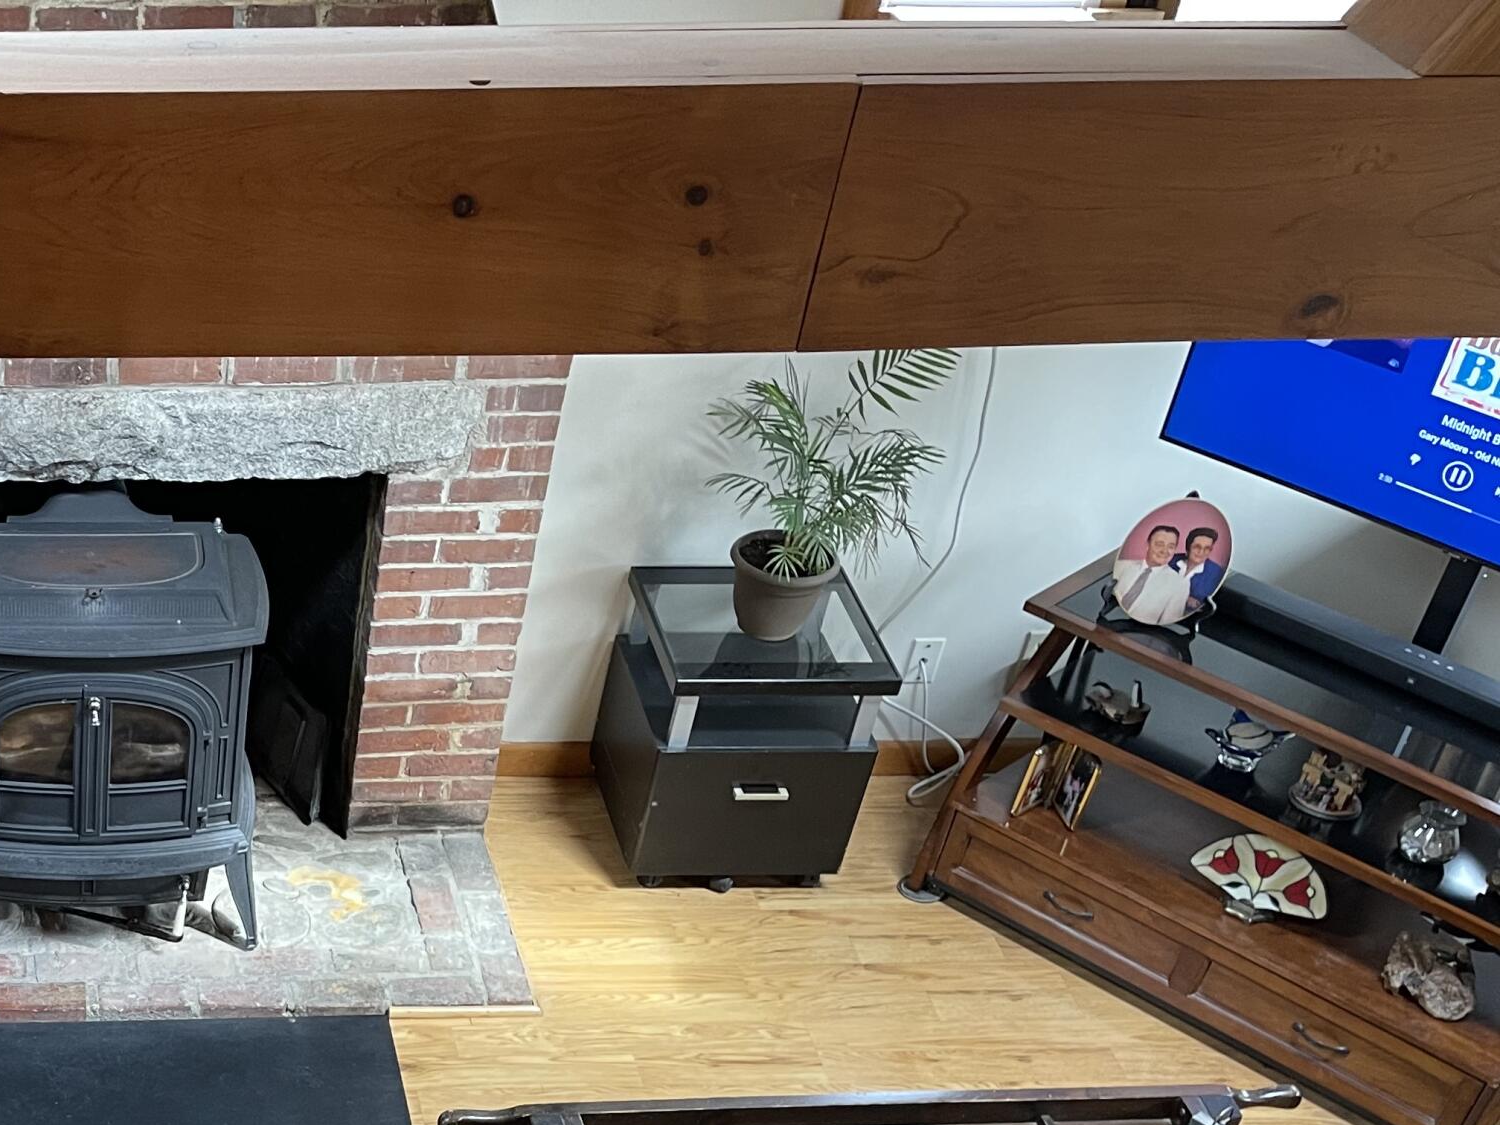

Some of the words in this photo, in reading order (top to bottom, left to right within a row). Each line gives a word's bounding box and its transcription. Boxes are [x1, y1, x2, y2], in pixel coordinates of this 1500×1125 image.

[1441, 415, 1492, 443] Midnight
[1418, 429, 1441, 446] Gary
[1440, 437, 1469, 456] Moore
[1474, 449, 1491, 464] Old
